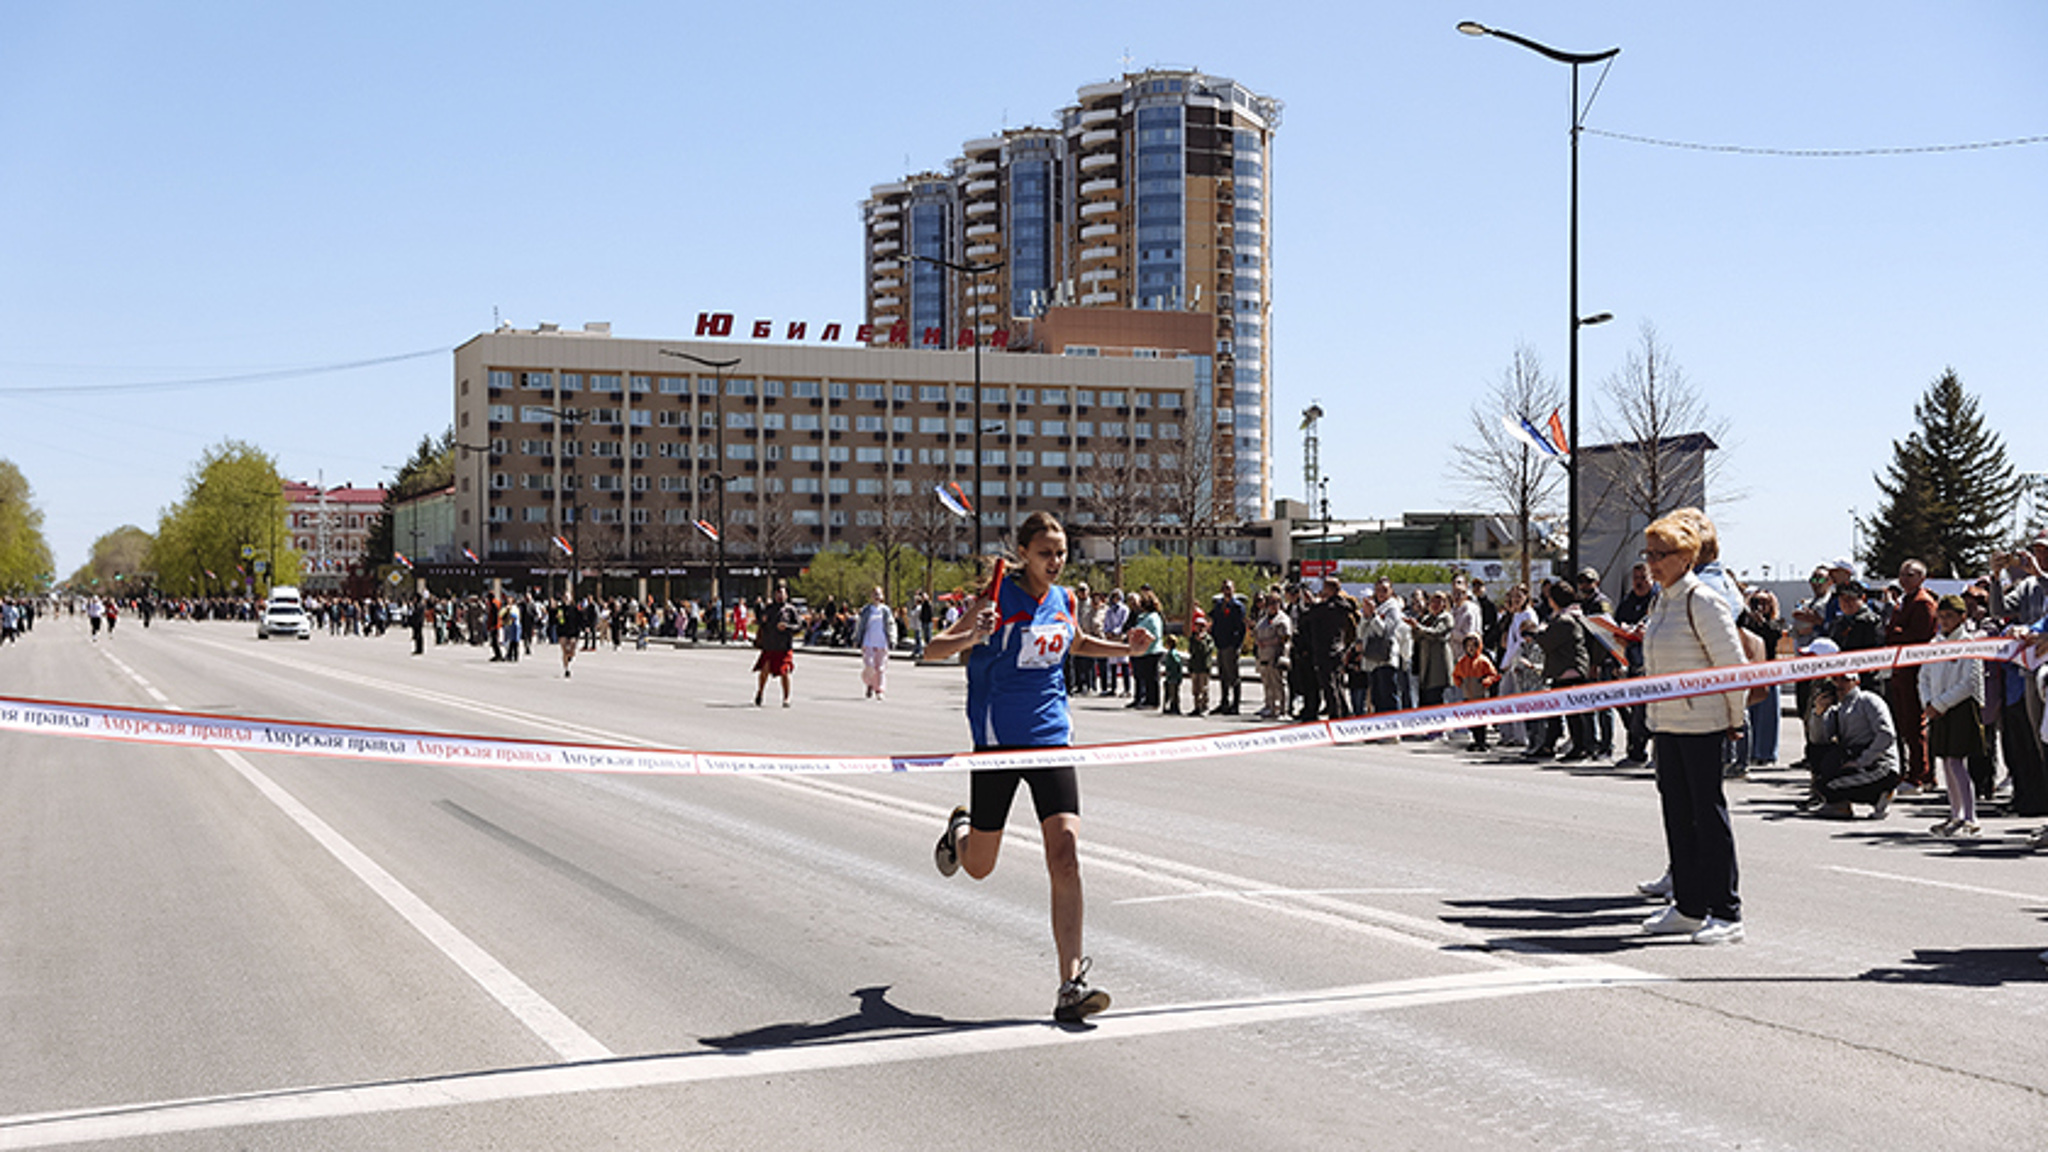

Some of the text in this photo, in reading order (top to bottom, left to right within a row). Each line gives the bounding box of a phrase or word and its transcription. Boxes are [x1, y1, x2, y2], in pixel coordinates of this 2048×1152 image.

[1788, 658, 1848, 674] Амурская
[1678, 668, 1782, 689] Амурская правда
[1565, 682, 1672, 705] Амурская правда
[24, 711, 89, 728] правда
[98, 714, 251, 741] Амурская правда
[1335, 722, 1399, 736] Амурская
[261, 728, 406, 753] Амурская правда
[414, 739, 551, 762] Амурская правда
[560, 751, 634, 768] Амурская
